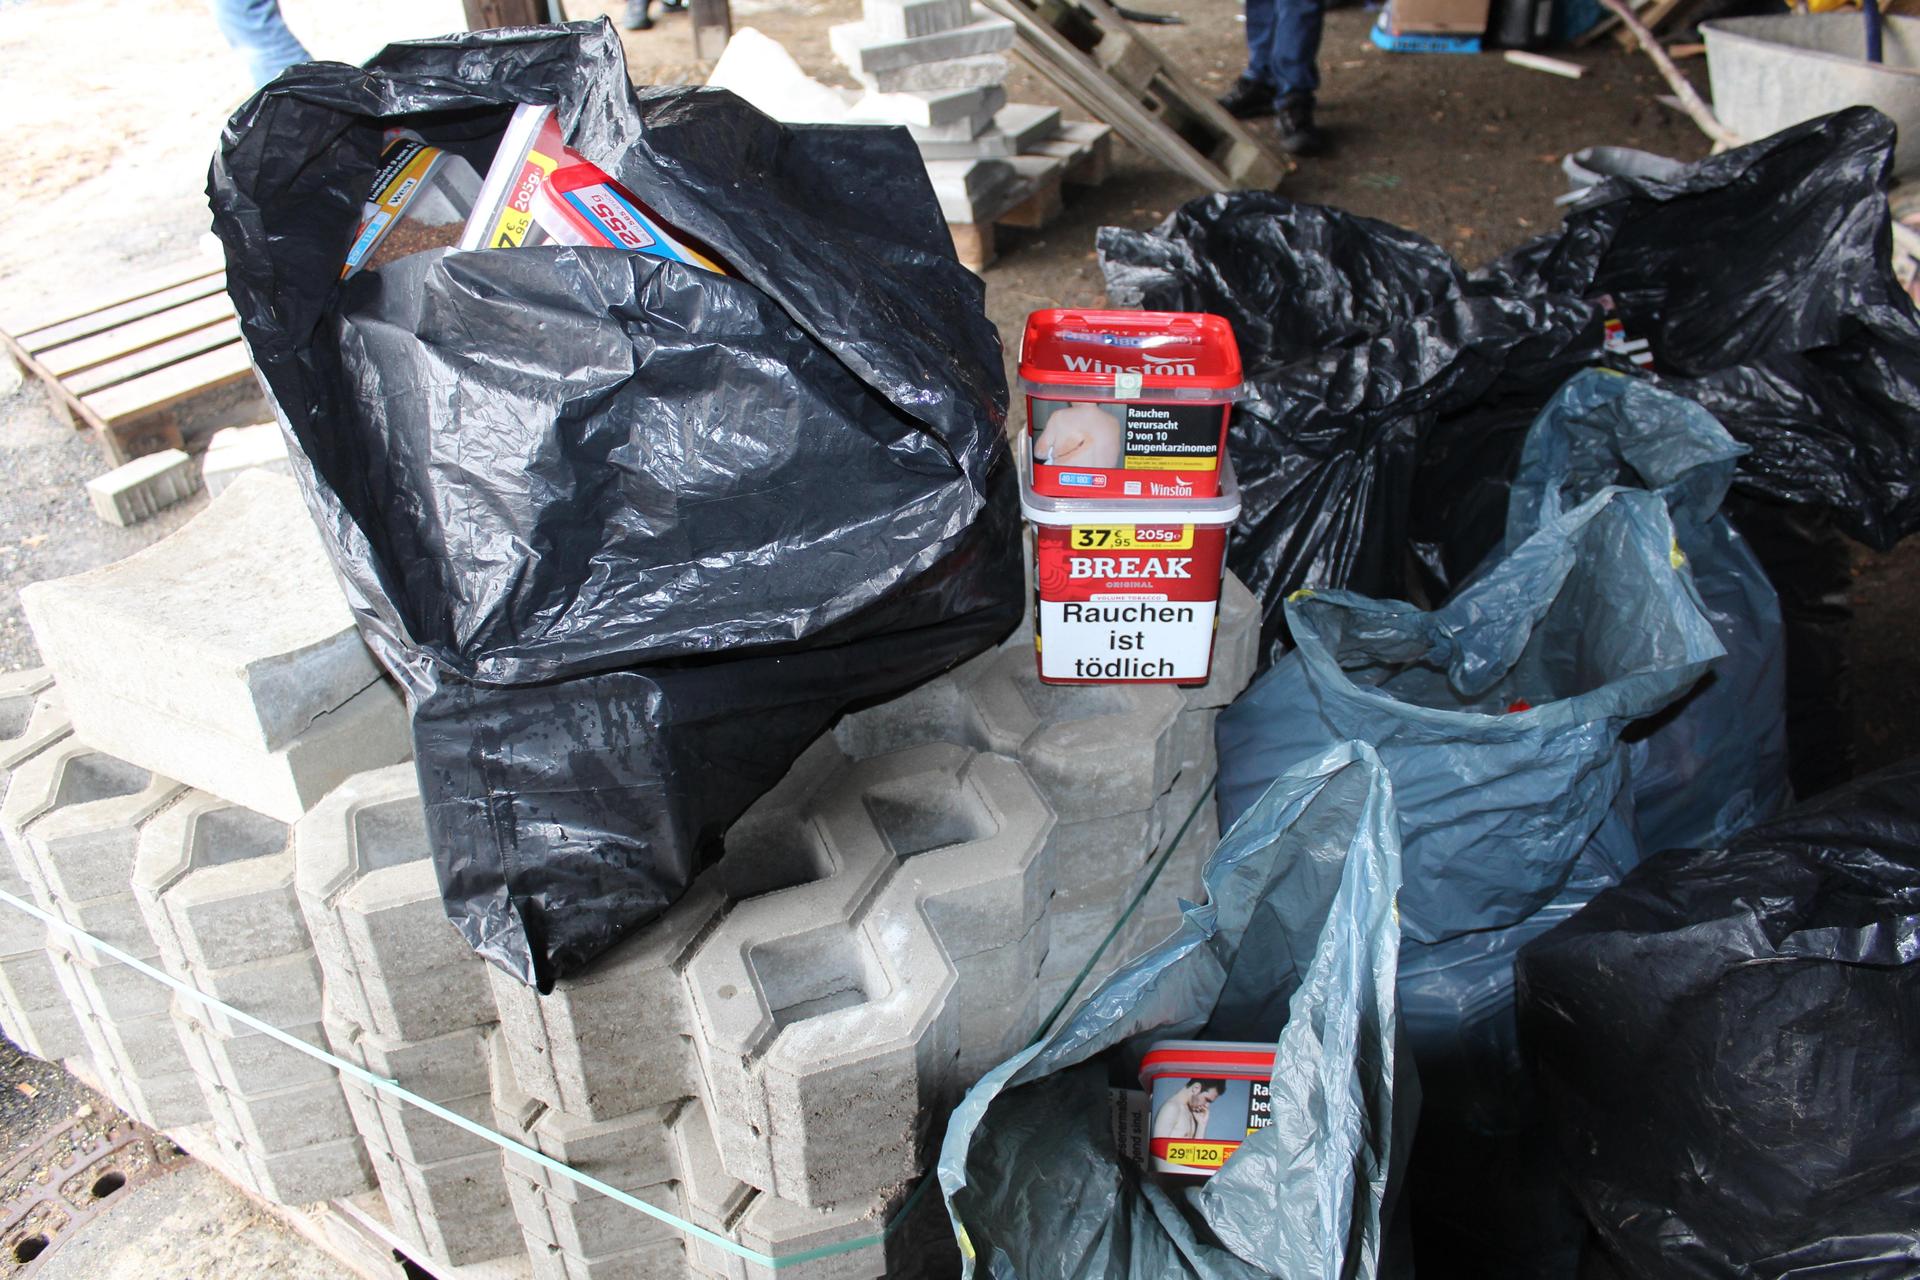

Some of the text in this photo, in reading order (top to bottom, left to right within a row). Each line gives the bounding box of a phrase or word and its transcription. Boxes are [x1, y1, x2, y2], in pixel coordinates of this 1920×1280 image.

[390, 180, 413, 203] West
[514, 173, 541, 211] 205g
[1063, 353, 1196, 376] Winston
[1128, 408, 1170, 419] Rauchen
[1127, 420, 1178, 430] verursacht
[1127, 431, 1168, 441] 9 von 10
[1126, 442, 1217, 454] Lungenkarzinomen
[1150, 481, 1192, 496] Winston
[1069, 557, 1193, 579] BREAK
[1105, 581, 1154, 589] ORIGINAL
[1063, 602, 1194, 623] Rauchen
[1109, 630, 1145, 650] ist
[1075, 657, 1175, 677] tödlich
[1197, 1149, 1218, 1160] 120
